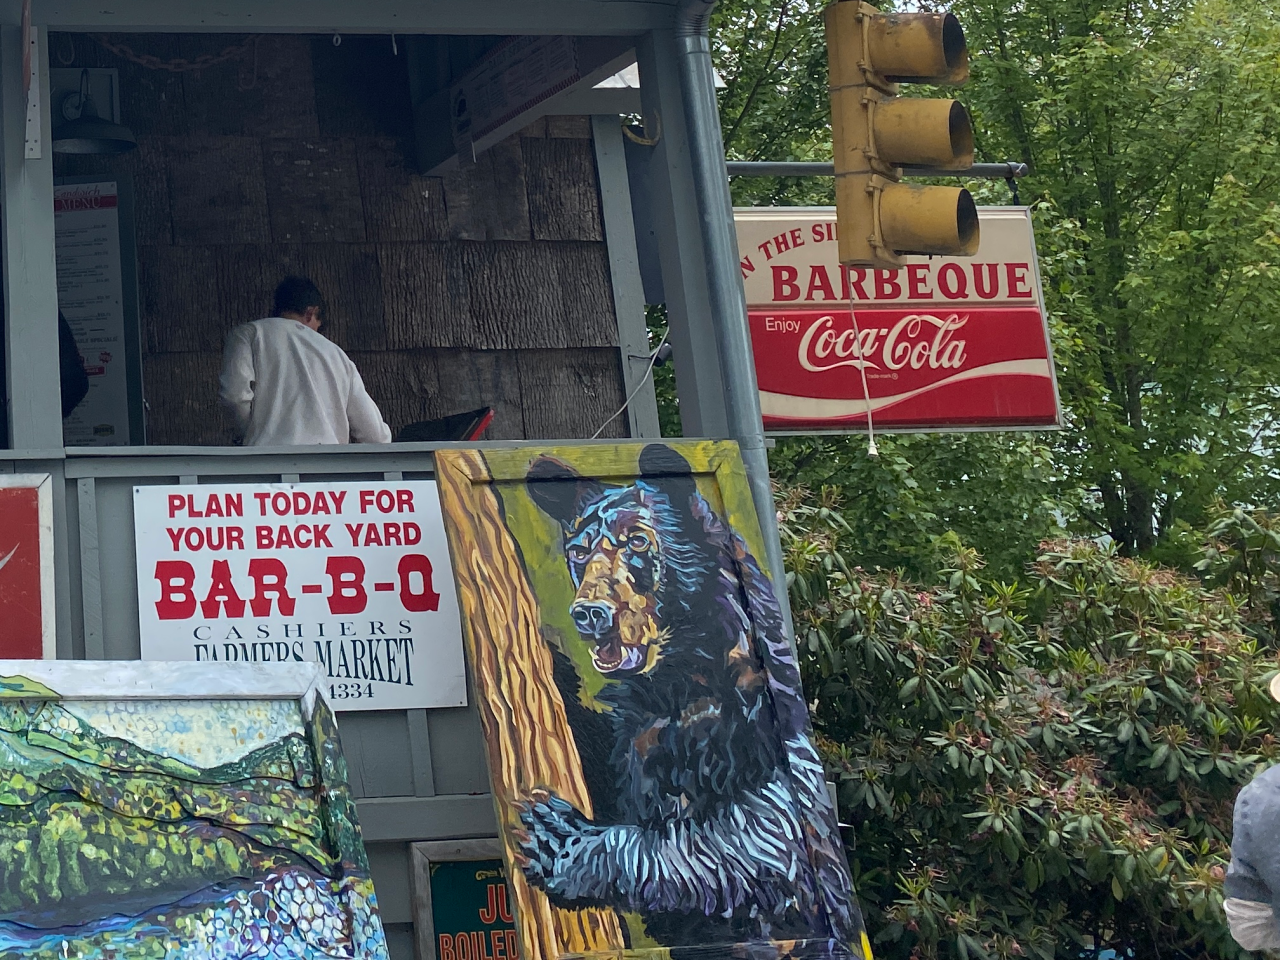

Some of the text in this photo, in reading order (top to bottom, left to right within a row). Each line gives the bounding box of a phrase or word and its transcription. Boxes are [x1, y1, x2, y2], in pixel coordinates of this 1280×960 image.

[61, 197, 100, 210] MENU
[739, 222, 839, 280] N THE SI
[770, 262, 1033, 302] BARBEQUE
[765, 317, 801, 334] Enjoy
[798, 313, 970, 372] Coca-Cola
[168, 489, 415, 519] PLAN TODAY FOR
[166, 522, 422, 552] YOUR BACK YARD
[154, 553, 441, 620] BAR-B-Q
[193, 620, 412, 640] CASHIERS
[313, 637, 414, 686] MARKET
[478, 883, 515, 924] JU
[438, 929, 520, 960] BOILED
